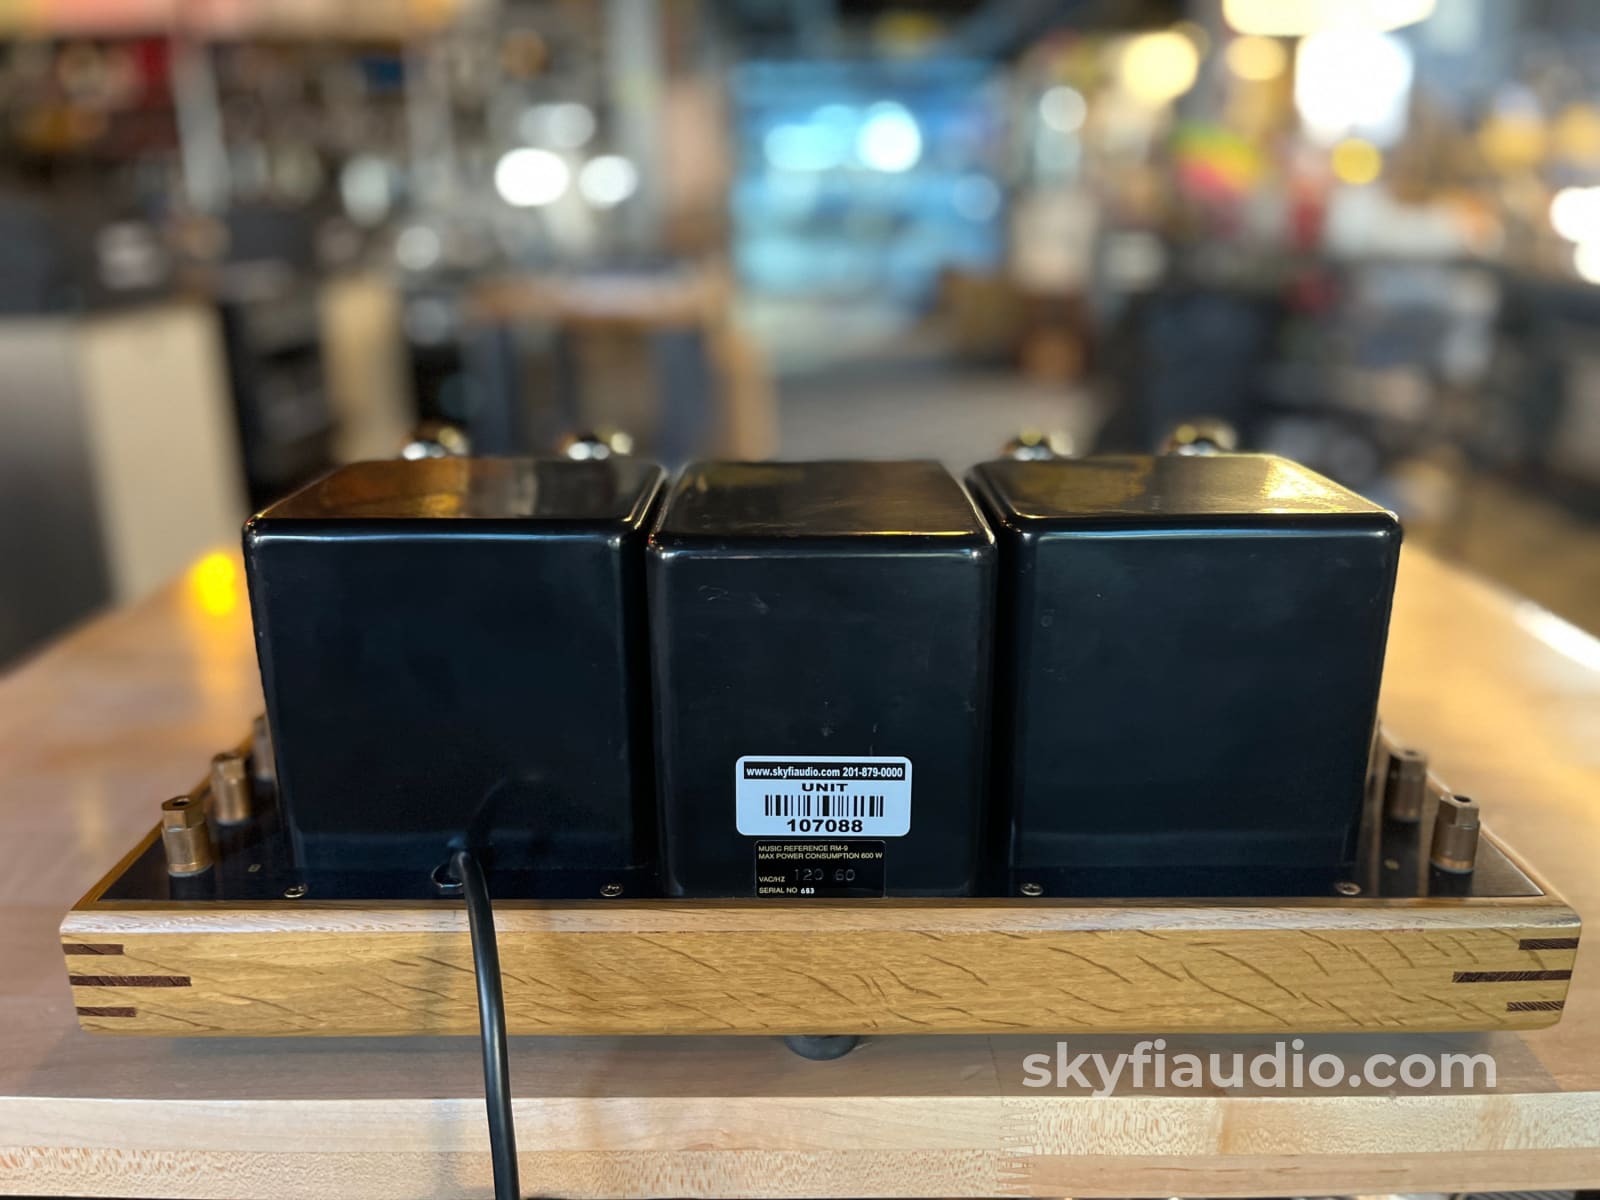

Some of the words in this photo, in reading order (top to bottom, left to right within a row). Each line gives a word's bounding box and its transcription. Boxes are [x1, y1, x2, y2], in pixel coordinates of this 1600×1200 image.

[746, 766, 840, 778] www.skyfiaudio.com
[842, 767, 903, 778] 201-879-0000
[801, 783, 848, 792] UNIT
[786, 819, 863, 833] 107088
[793, 868, 825, 881] 120
[834, 868, 856, 881] 60
